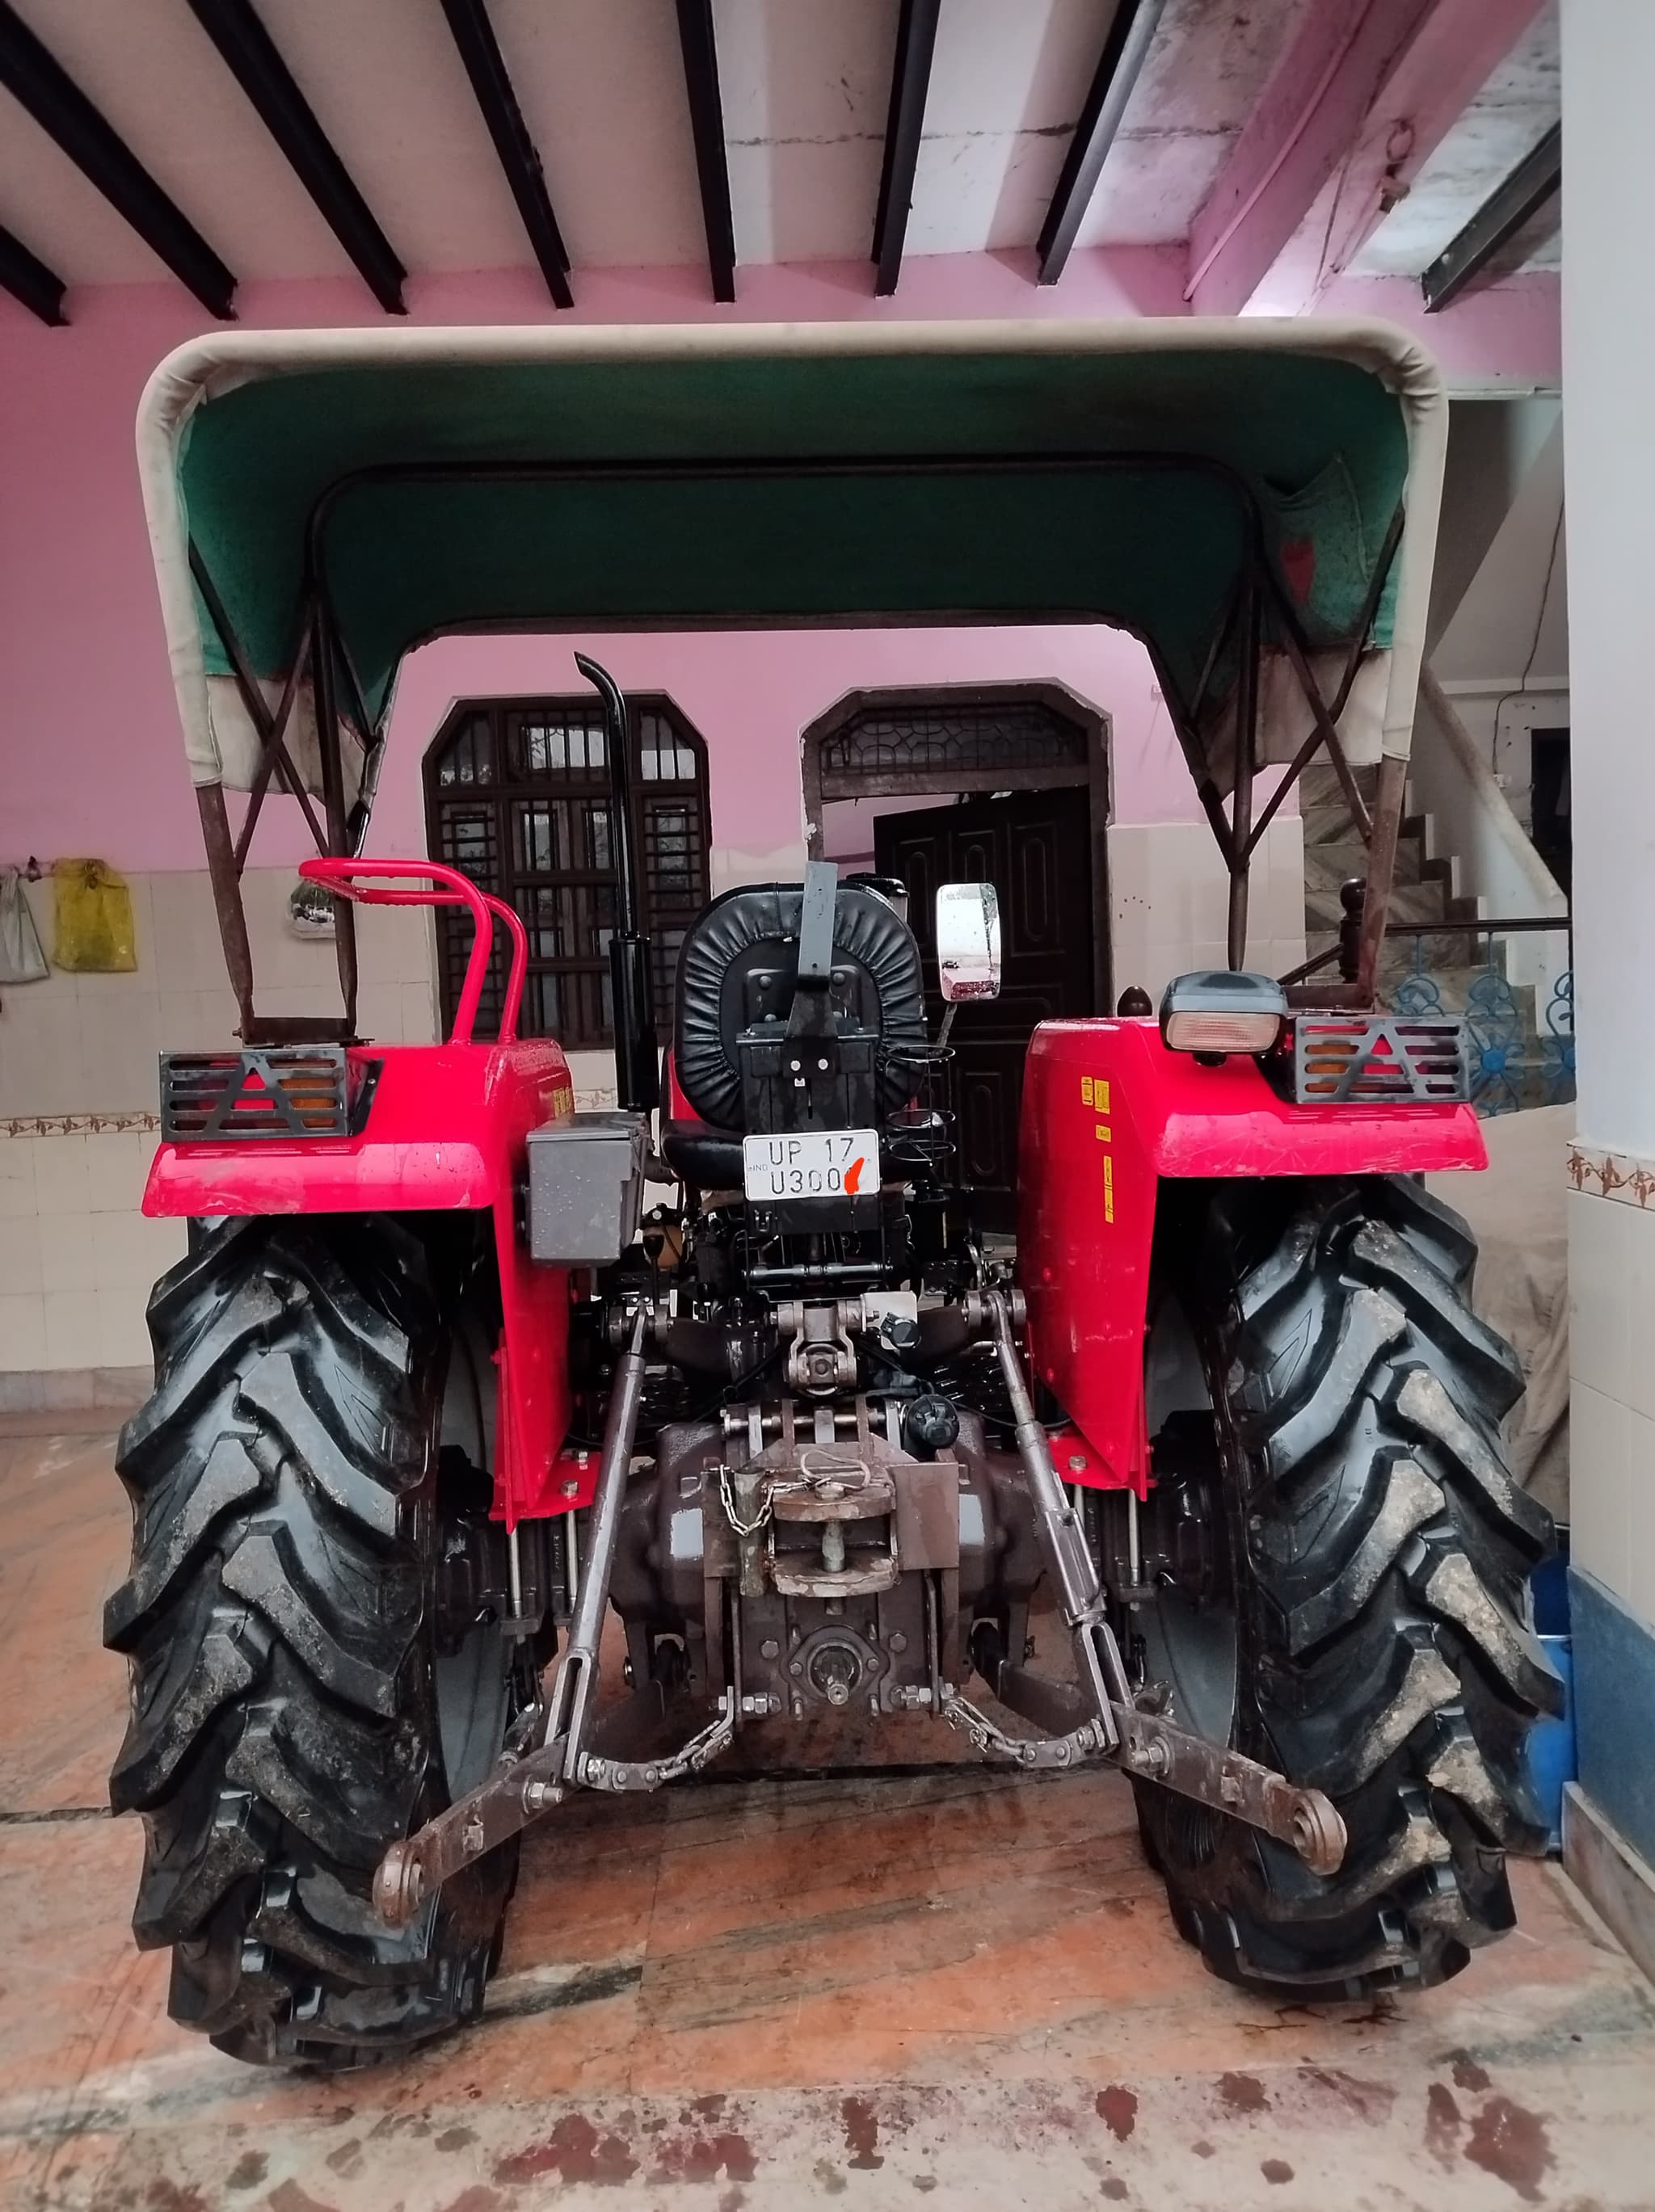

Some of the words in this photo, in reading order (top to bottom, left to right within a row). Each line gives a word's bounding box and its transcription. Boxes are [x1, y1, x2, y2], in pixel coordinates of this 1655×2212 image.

[769, 1140, 802, 1165] UP
[825, 1138, 855, 1163] 17
[752, 1163, 769, 1171] IND
[771, 1167, 860, 1195] U300
